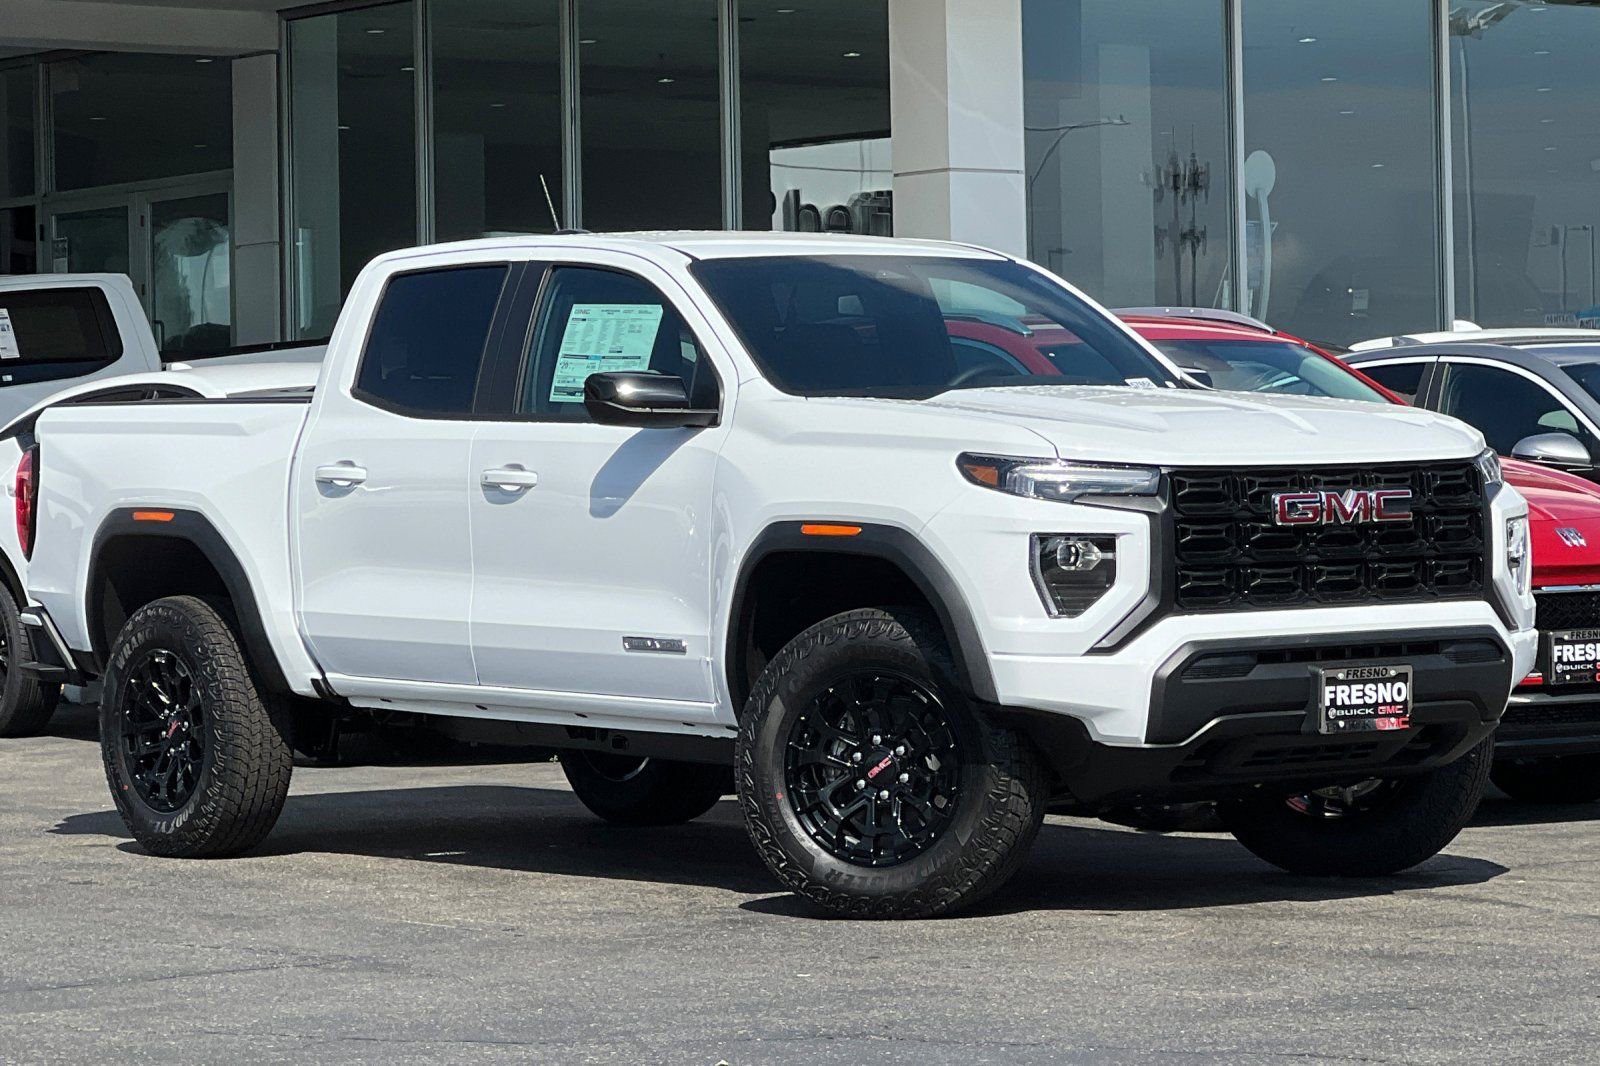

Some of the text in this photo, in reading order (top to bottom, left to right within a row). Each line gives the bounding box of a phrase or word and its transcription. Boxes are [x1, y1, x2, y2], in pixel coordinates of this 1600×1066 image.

[1272, 489, 1413, 526] GMC
[1570, 630, 1600, 639] FRESN
[1563, 663, 1594, 671] BUICK
[1345, 667, 1388, 679] FRESNO
[1324, 681, 1407, 706] FRESNO
[1336, 705, 1404, 716] BUICK GMC
